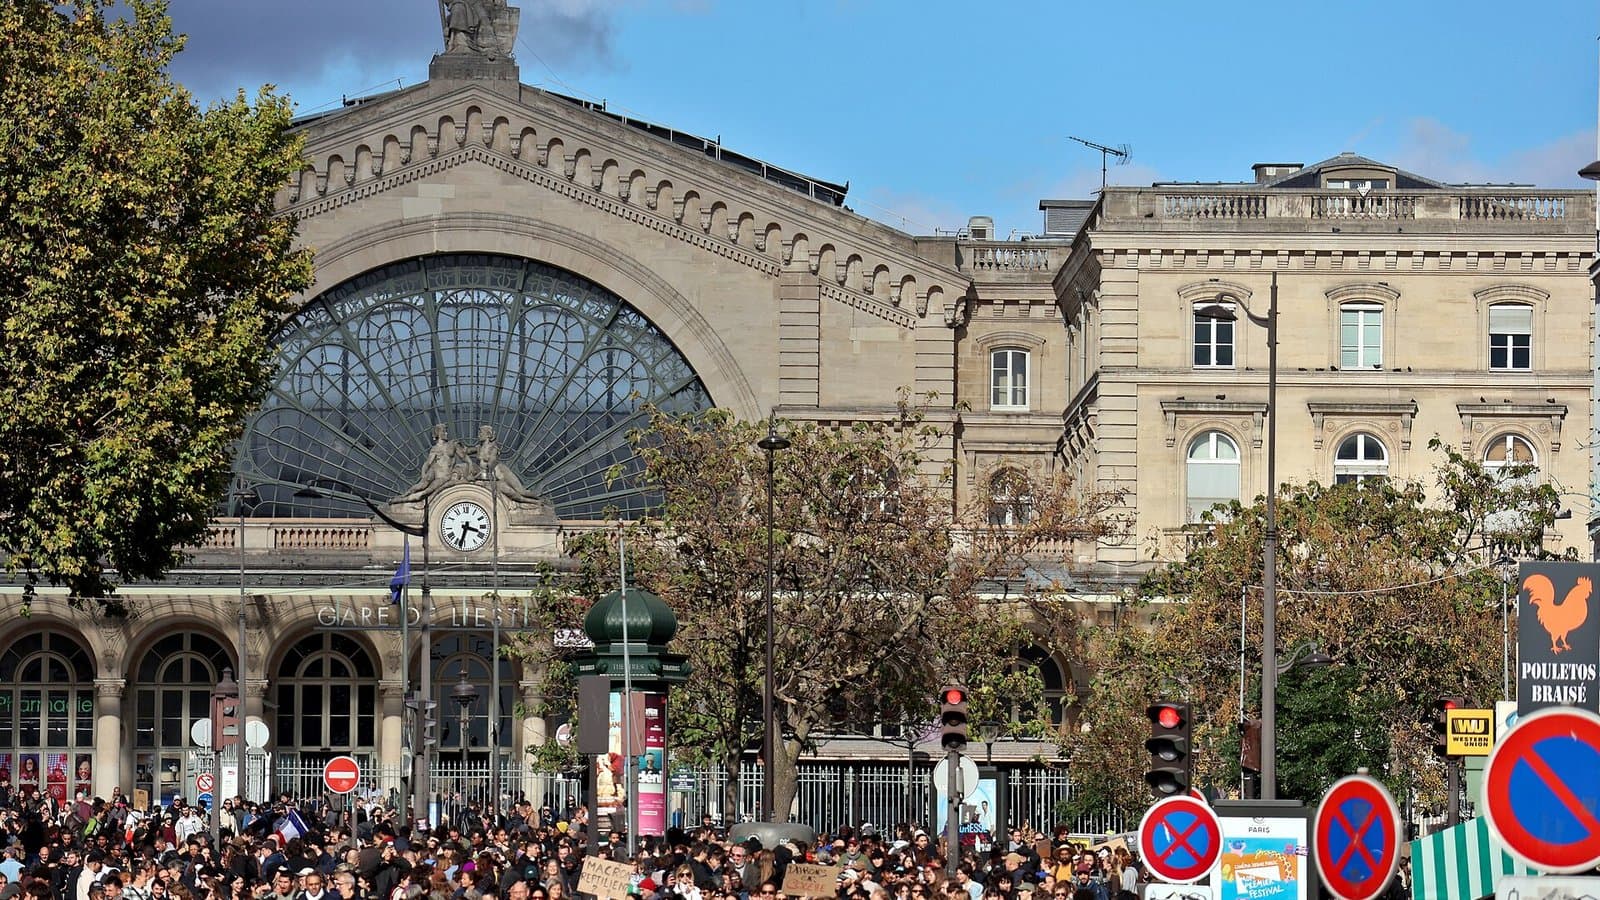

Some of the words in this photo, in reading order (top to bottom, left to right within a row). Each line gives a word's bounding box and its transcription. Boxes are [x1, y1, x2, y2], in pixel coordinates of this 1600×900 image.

[317, 606, 389, 626] GARE
[1521, 661, 1597, 681] POULETOS
[1532, 681, 1587, 703] BRAISÉ
[0, 695, 93, 712] Pharmaie
[1453, 719, 1485, 733] WU
[1248, 826, 1271, 834] PARIS
[1249, 886, 1285, 899] FESTIVAL
